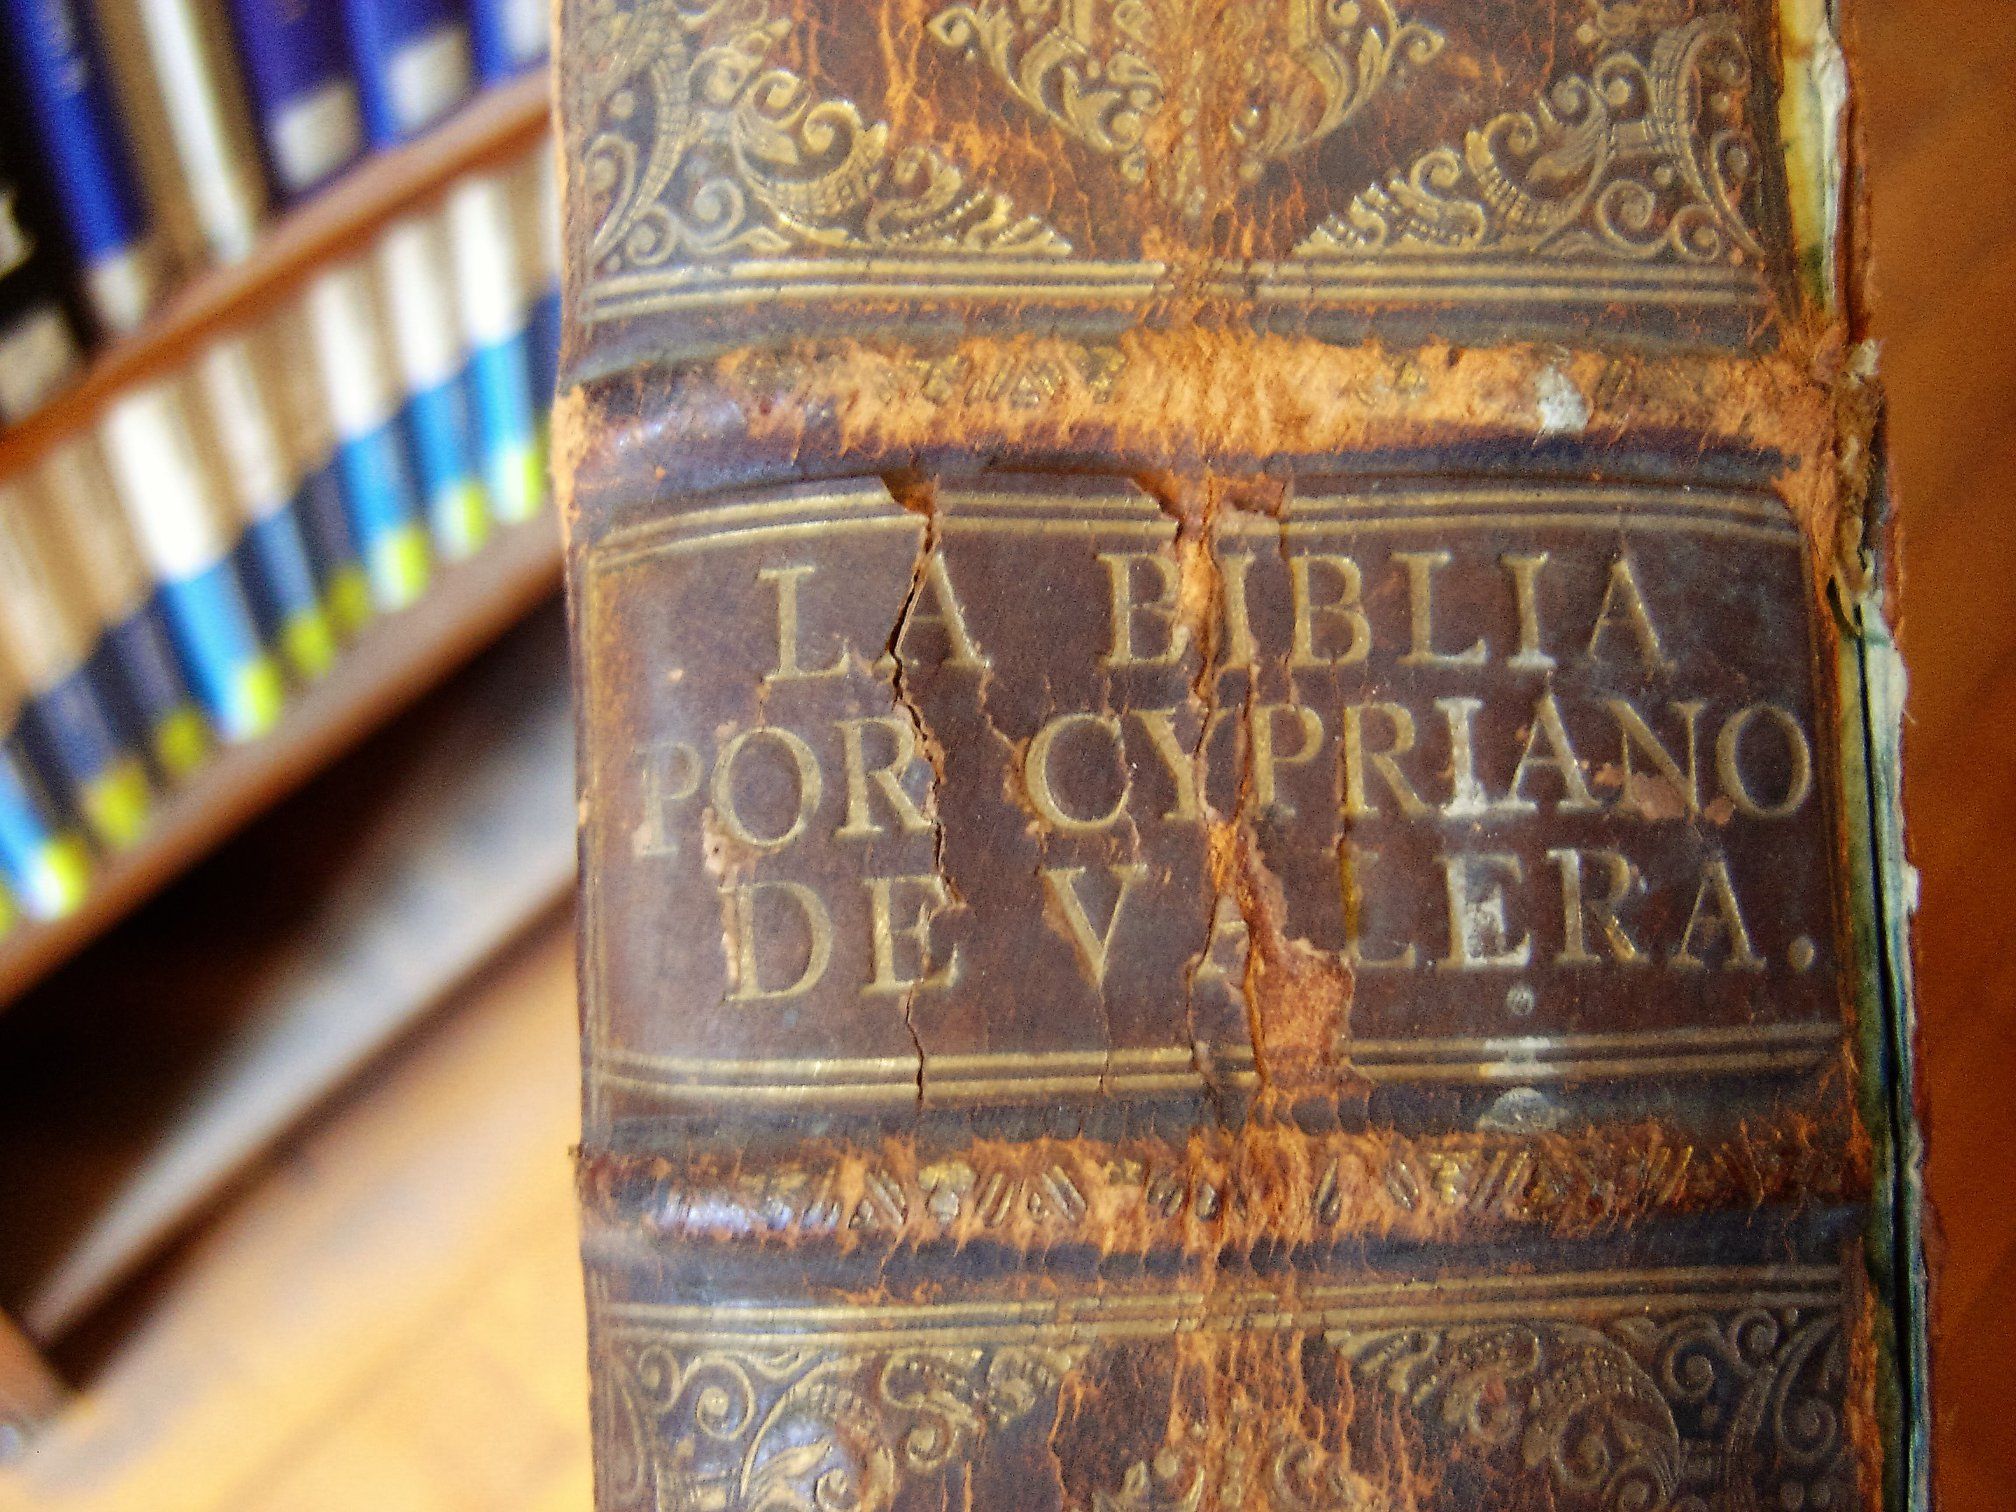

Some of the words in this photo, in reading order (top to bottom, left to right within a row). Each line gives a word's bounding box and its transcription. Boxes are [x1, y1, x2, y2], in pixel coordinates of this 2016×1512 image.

[757, 550, 992, 684] LA
[1098, 550, 1678, 676] BIBLIA
[633, 714, 938, 859] POR
[1024, 691, 1813, 833] CYPRIANO
[717, 874, 964, 1002] DE
